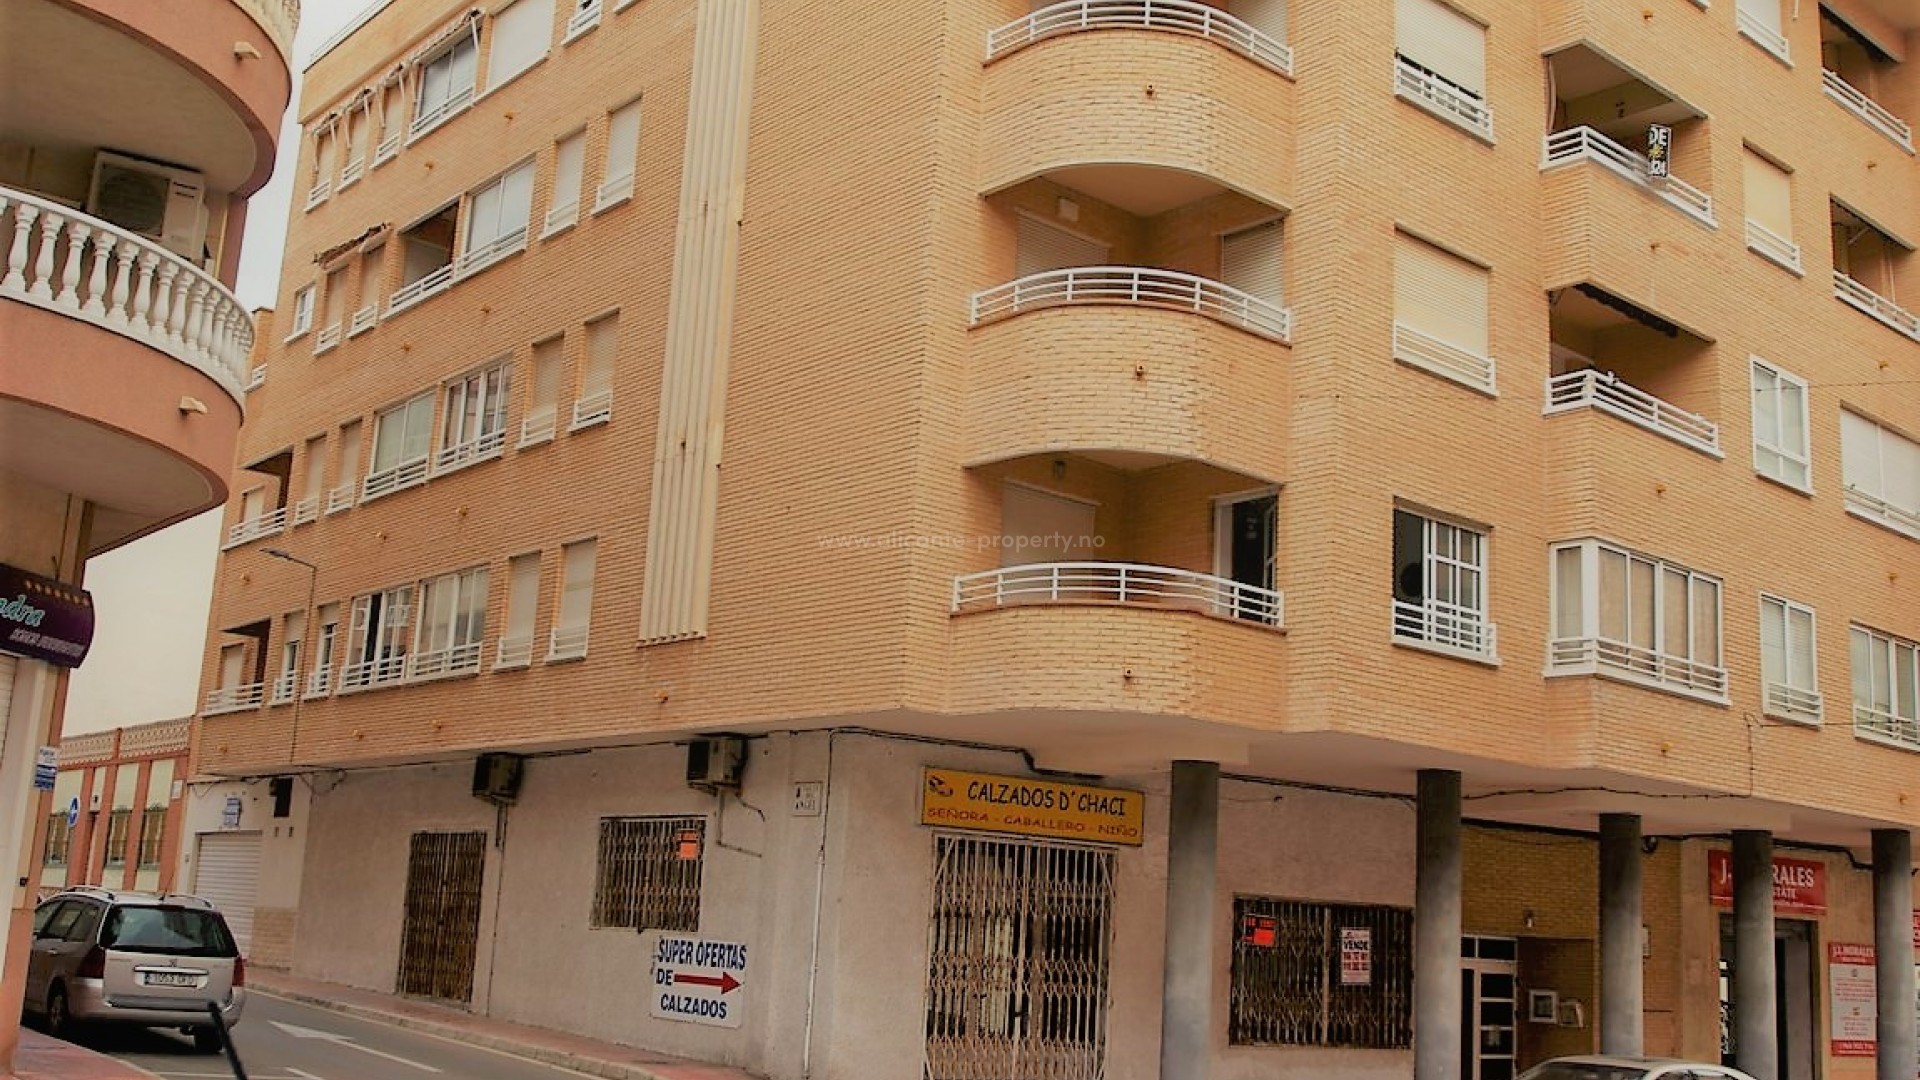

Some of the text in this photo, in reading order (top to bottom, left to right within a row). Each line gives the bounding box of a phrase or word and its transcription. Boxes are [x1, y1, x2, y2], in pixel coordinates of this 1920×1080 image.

[967, 781, 1054, 809] CALZADOS
[1003, 815, 1085, 833] CABALLERO
[657, 938, 747, 971] SUPER OFERTAS
[656, 968, 674, 986] DE
[660, 993, 728, 1020] CALZADOS
